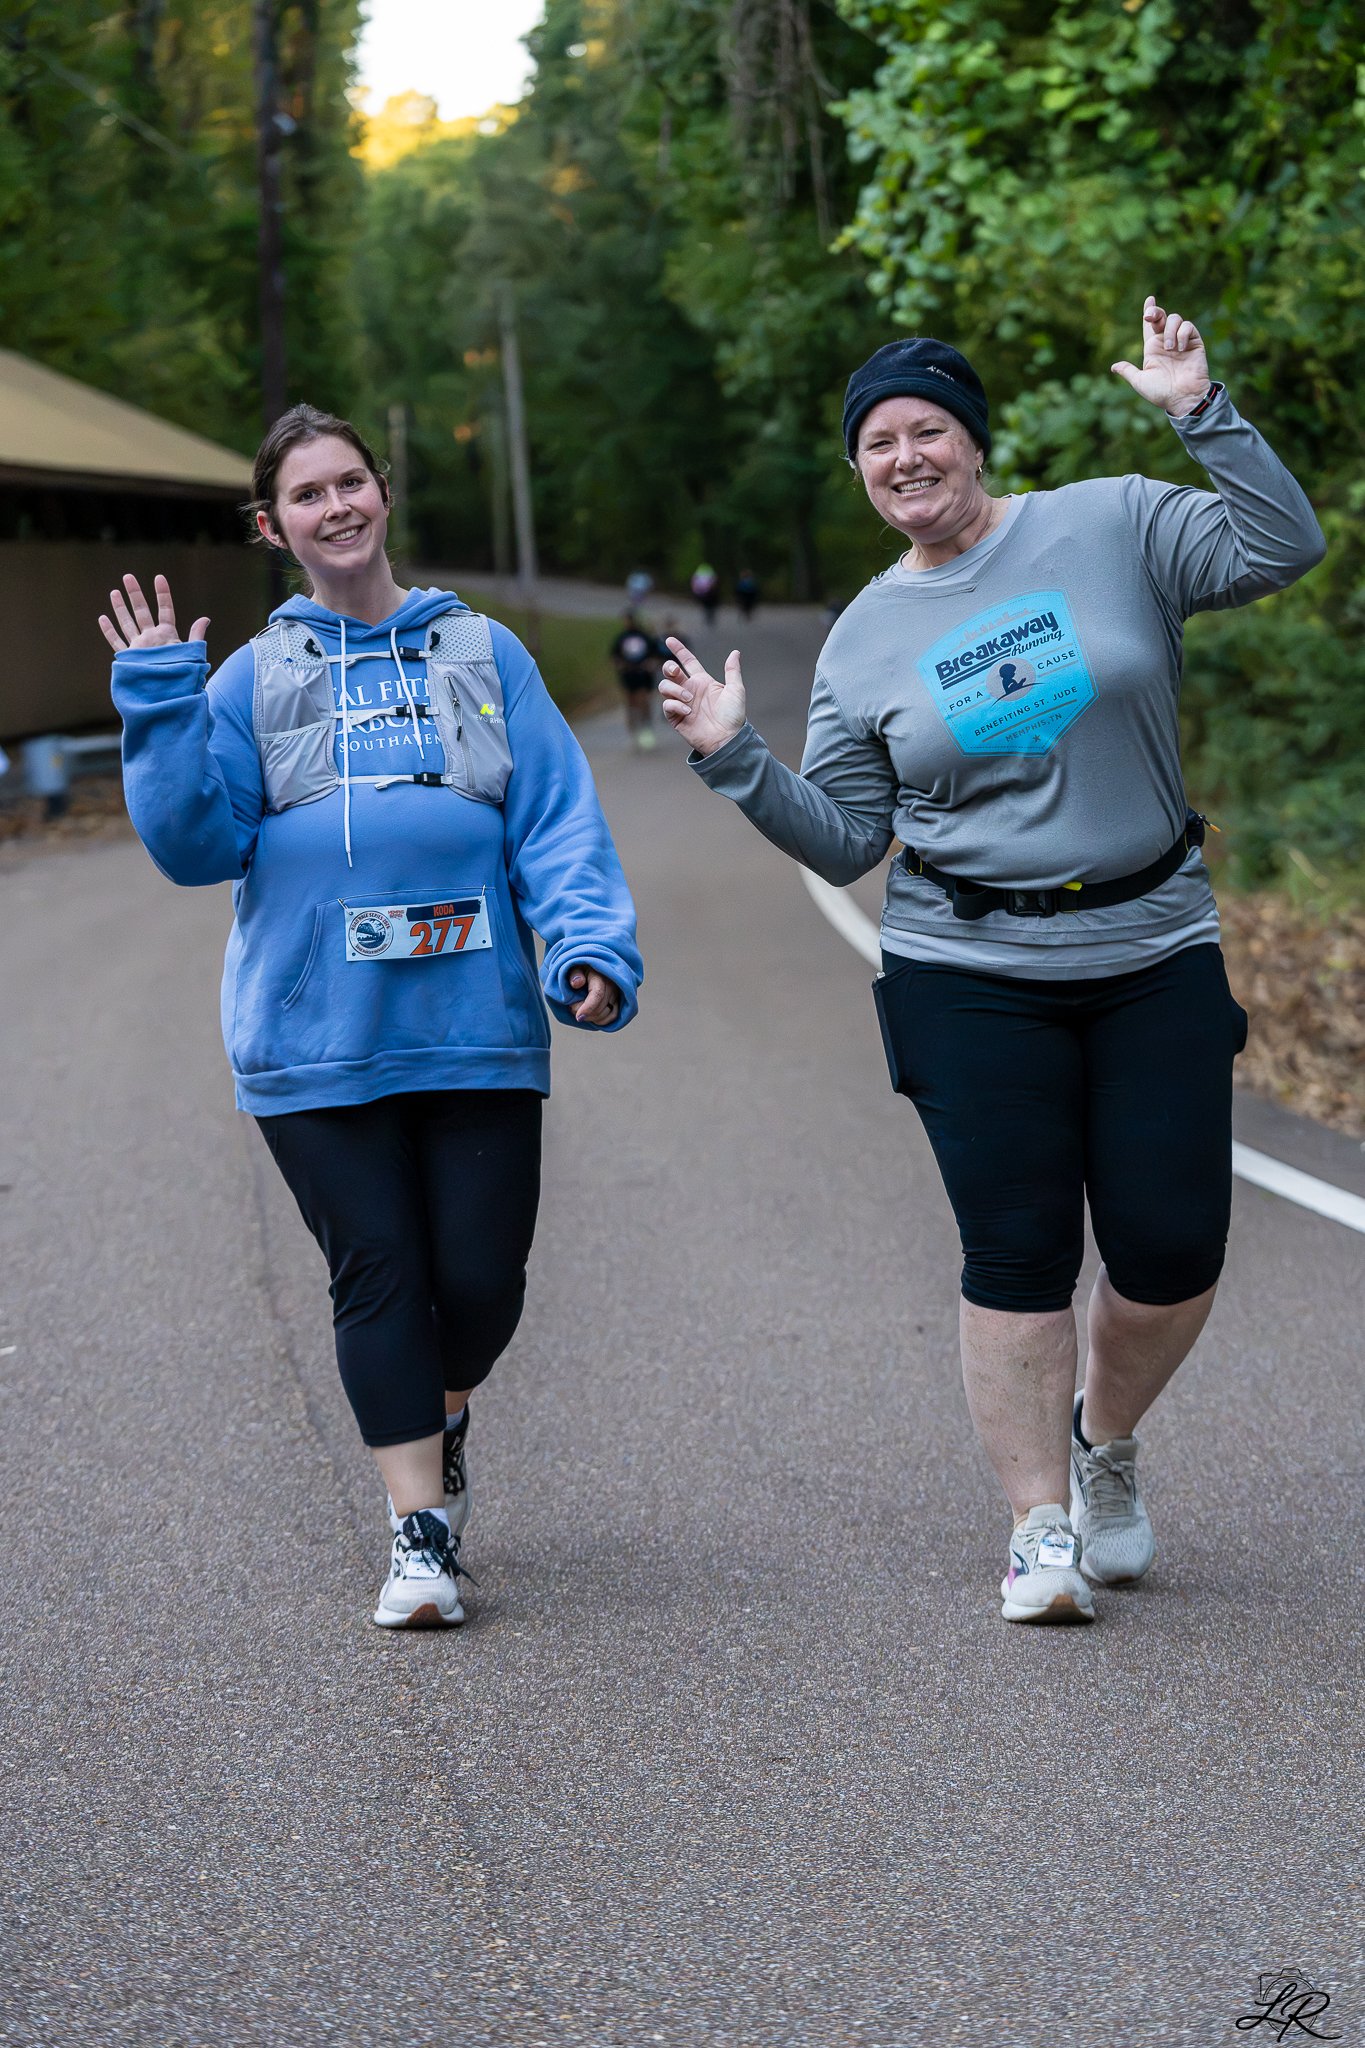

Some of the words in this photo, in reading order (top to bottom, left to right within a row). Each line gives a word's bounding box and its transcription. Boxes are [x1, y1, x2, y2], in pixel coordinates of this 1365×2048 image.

[935, 611, 1059, 681] Breakaway
[1011, 630, 1065, 657] Running
[333, 684, 372, 707] AL
[948, 696, 971, 711] FOR
[976, 690, 984, 699] A
[1037, 650, 1076, 670] CAUSE
[974, 705, 1031, 737] BENEFITING
[1033, 697, 1049, 709] ST.
[1052, 686, 1078, 701] JUDE
[433, 904, 455, 917] KODA
[409, 915, 476, 956] 277
